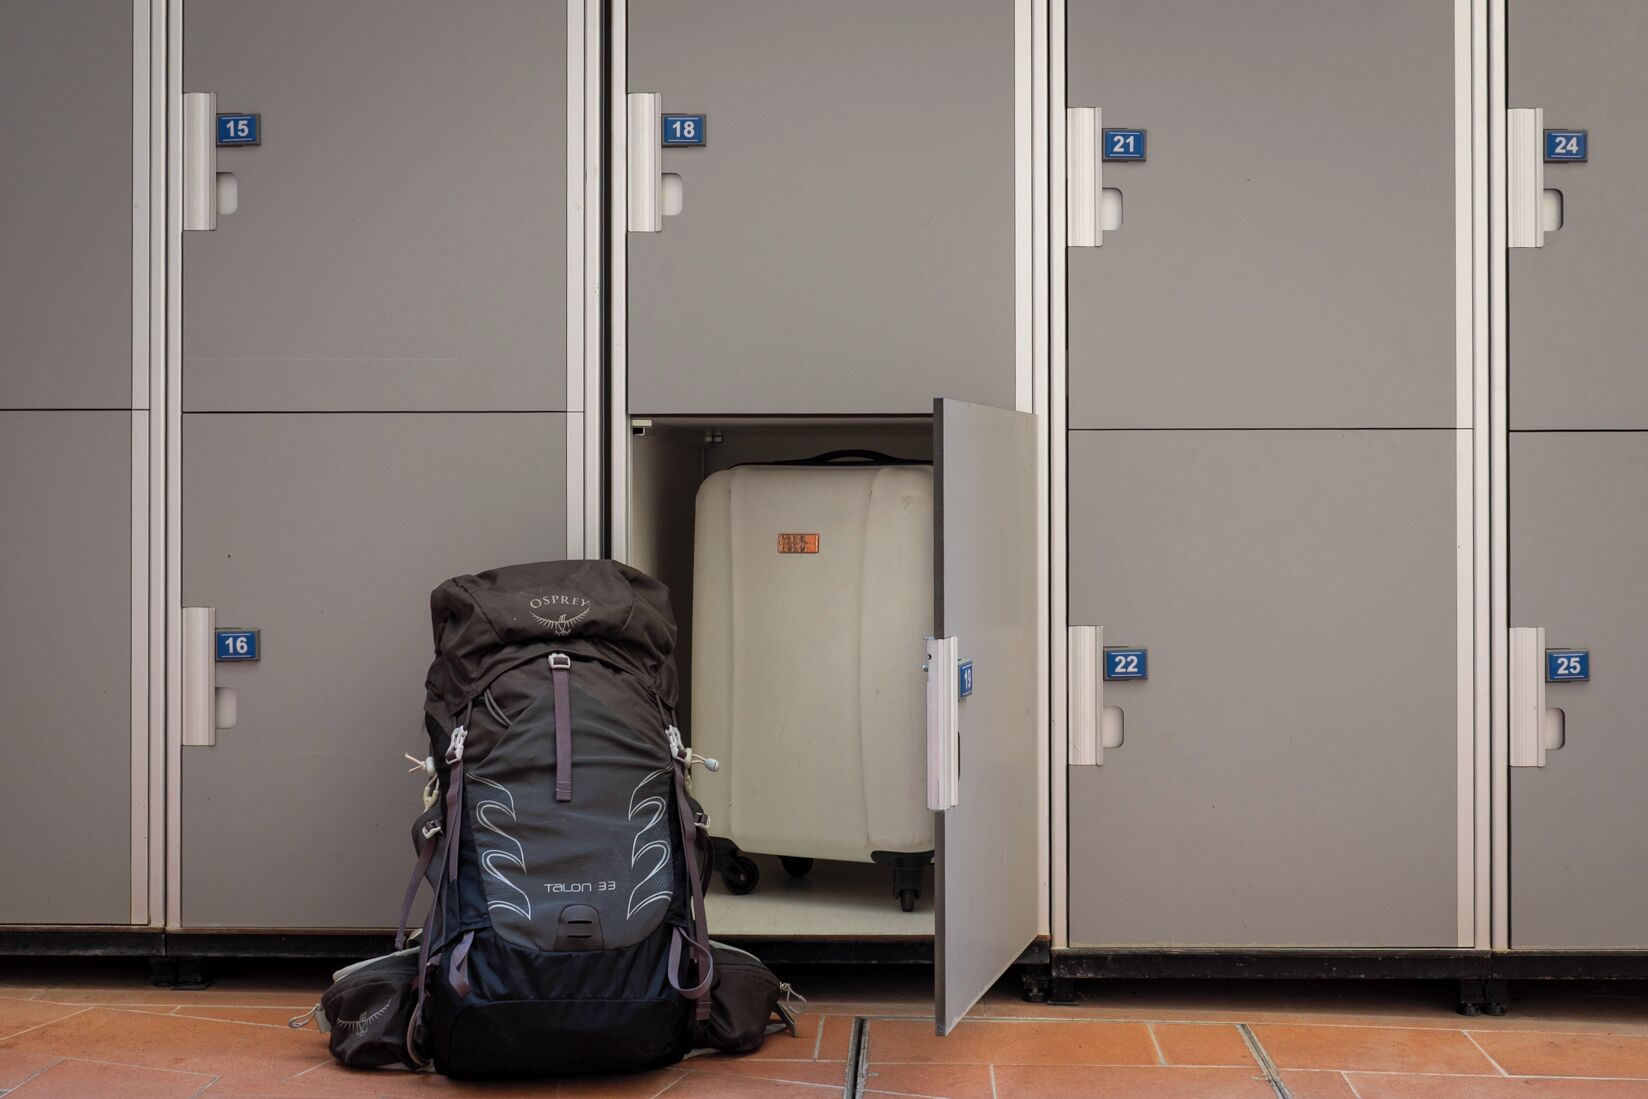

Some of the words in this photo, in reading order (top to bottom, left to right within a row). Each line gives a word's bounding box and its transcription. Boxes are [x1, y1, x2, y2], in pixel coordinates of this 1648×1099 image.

[226, 120, 249, 137] 15
[672, 121, 695, 138] 18
[1112, 135, 1134, 152] 21
[1554, 136, 1579, 154] 24
[530, 595, 590, 608] OSPREY
[225, 636, 248, 653] 16
[1114, 655, 1138, 673] 22
[1557, 657, 1581, 674] 25
[964, 669, 972, 690] 19
[598, 880, 616, 891] 33
